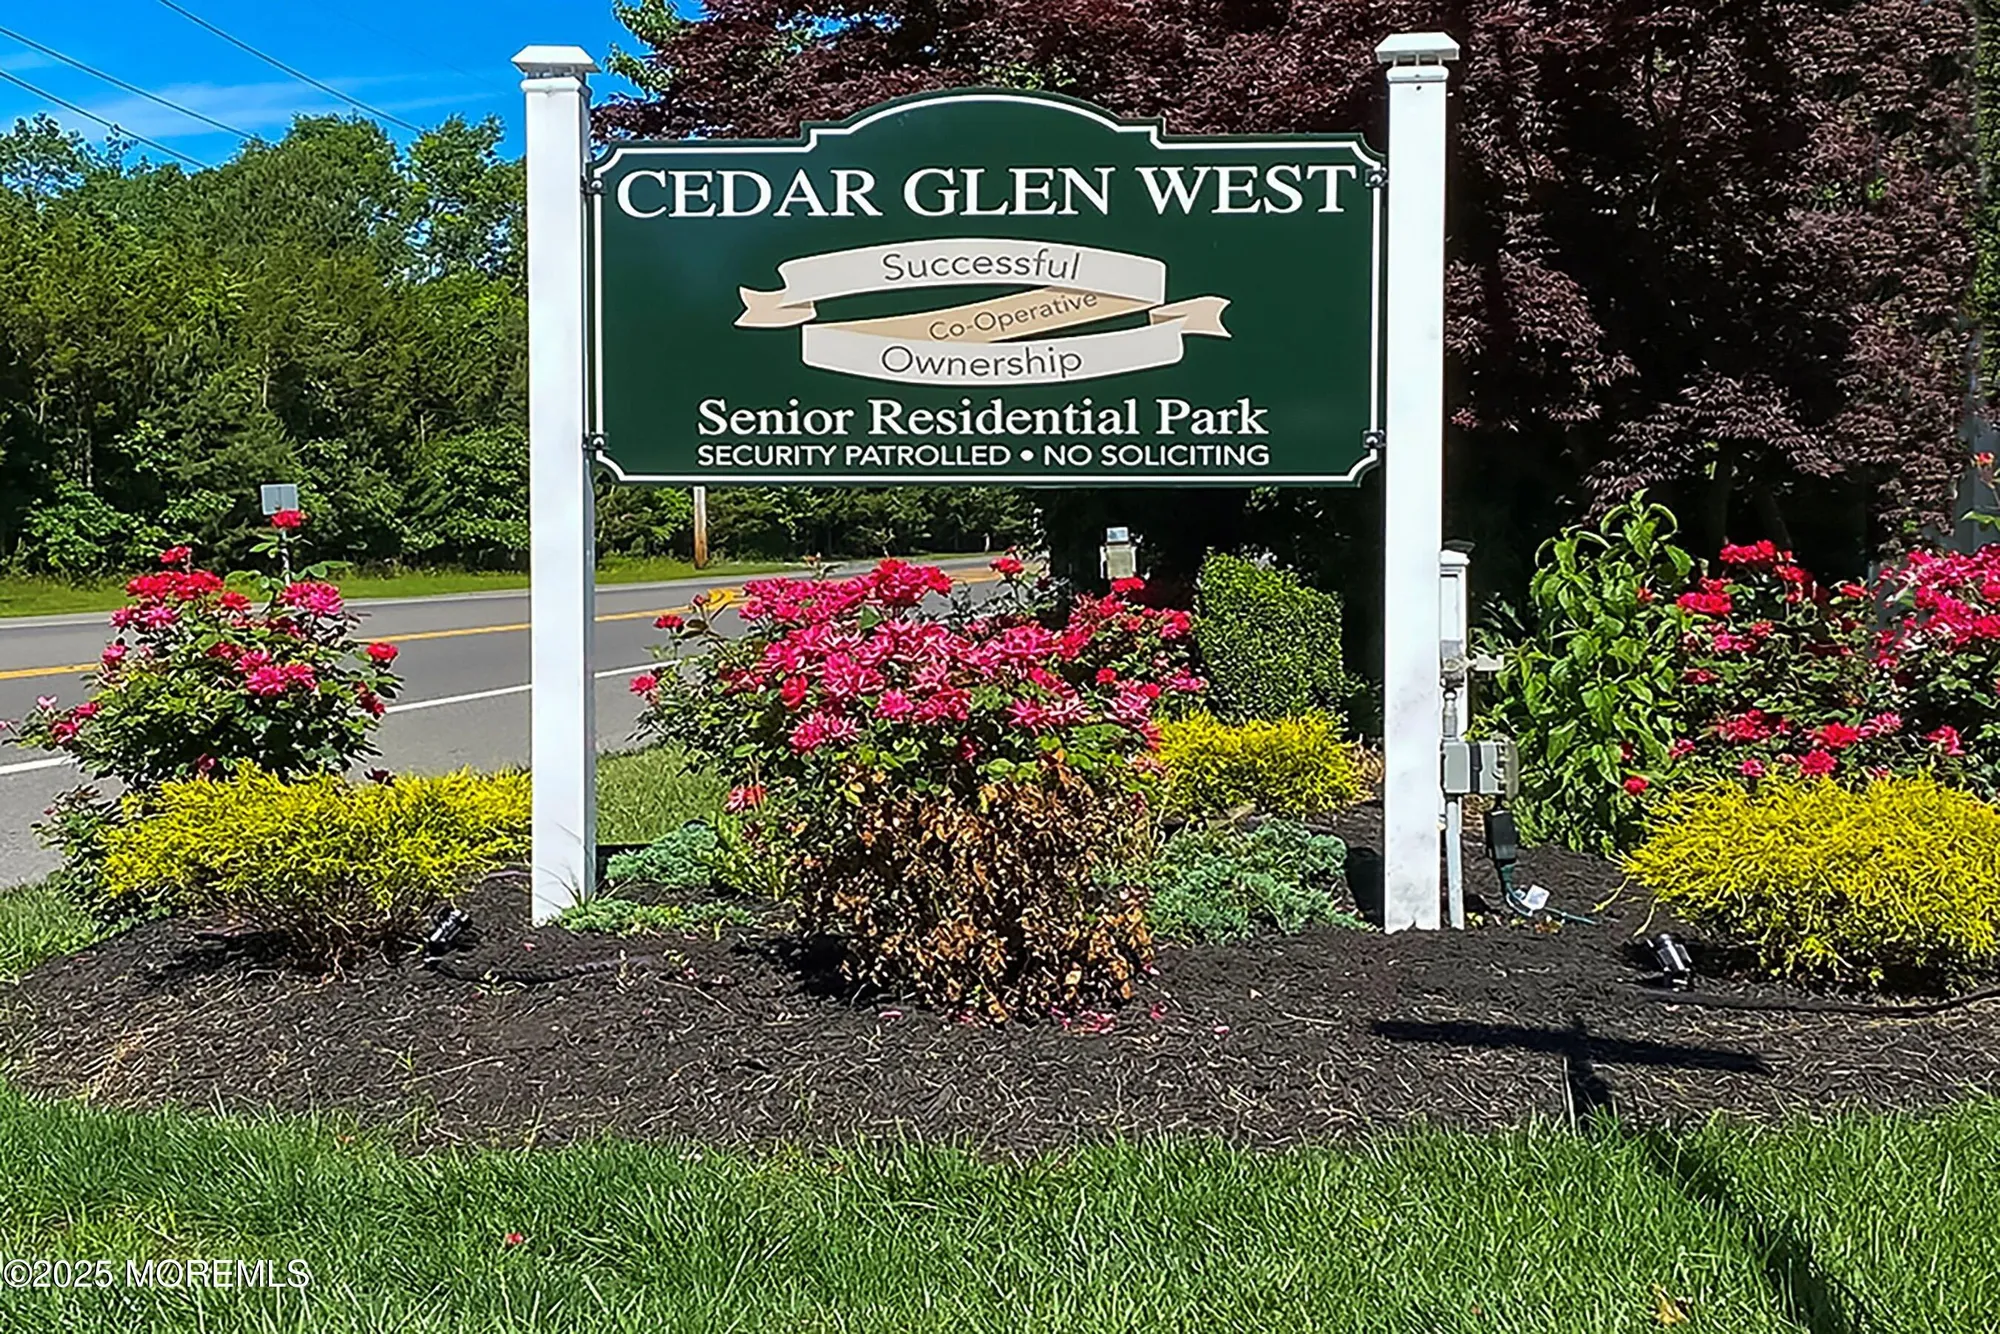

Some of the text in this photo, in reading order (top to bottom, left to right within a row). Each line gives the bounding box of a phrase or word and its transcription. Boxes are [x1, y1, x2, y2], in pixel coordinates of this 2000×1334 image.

[616, 165, 1356, 218] CEDAR GLEN WEST
[881, 249, 1081, 281] Successful
[928, 291, 1098, 341] Co-Operative
[880, 345, 1083, 380] Ownership
[699, 398, 1268, 435] Senior Residential Park
[699, 445, 1268, 465] SECURITY PATROLLED NO SOLICITING
